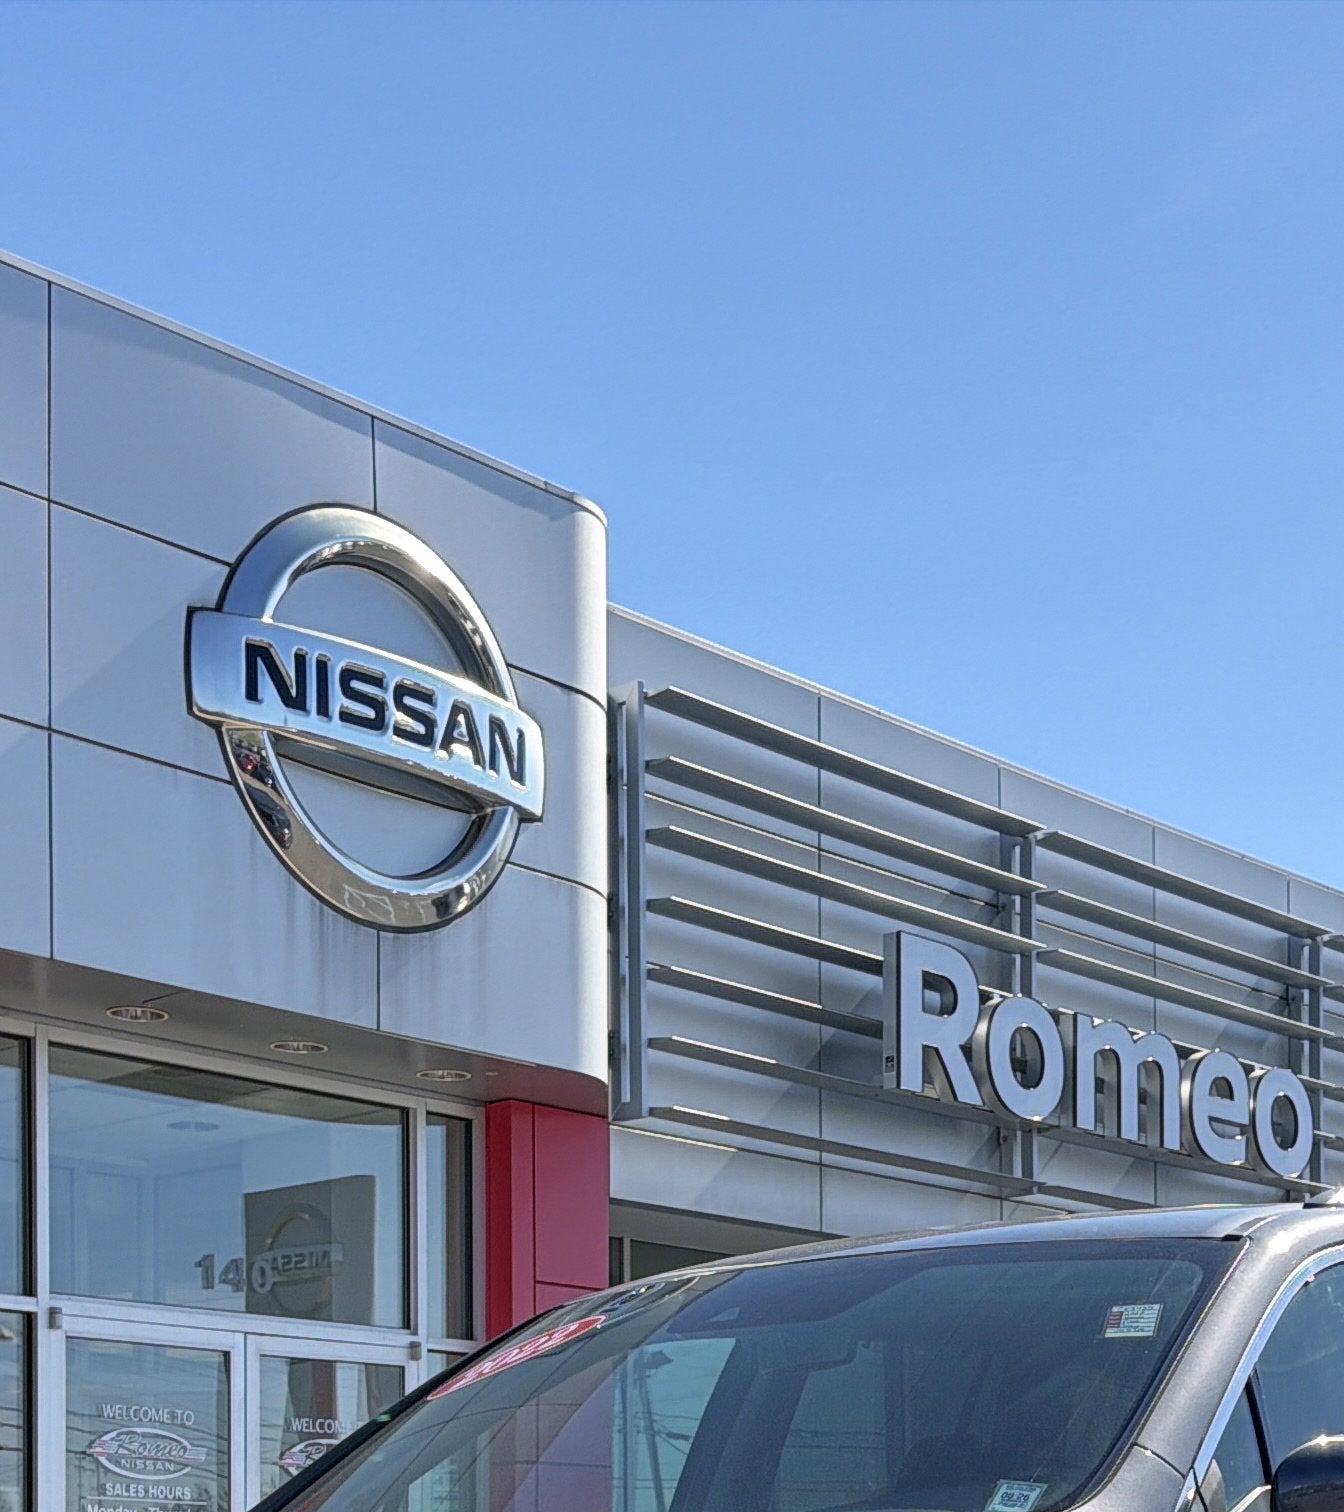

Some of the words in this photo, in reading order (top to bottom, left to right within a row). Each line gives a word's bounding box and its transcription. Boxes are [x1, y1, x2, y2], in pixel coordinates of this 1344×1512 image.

[244, 637, 528, 790] NISSAN
[883, 930, 1314, 1178] Romeo
[195, 1254, 274, 1294] 140
[102, 1404, 171, 1424] WELCOME
[176, 1409, 195, 1425] TO
[112, 1430, 189, 1458] Romeo
[120, 1459, 175, 1472] NISSAN
[106, 1482, 145, 1498] SALES
[148, 1485, 192, 1500] HOURS
